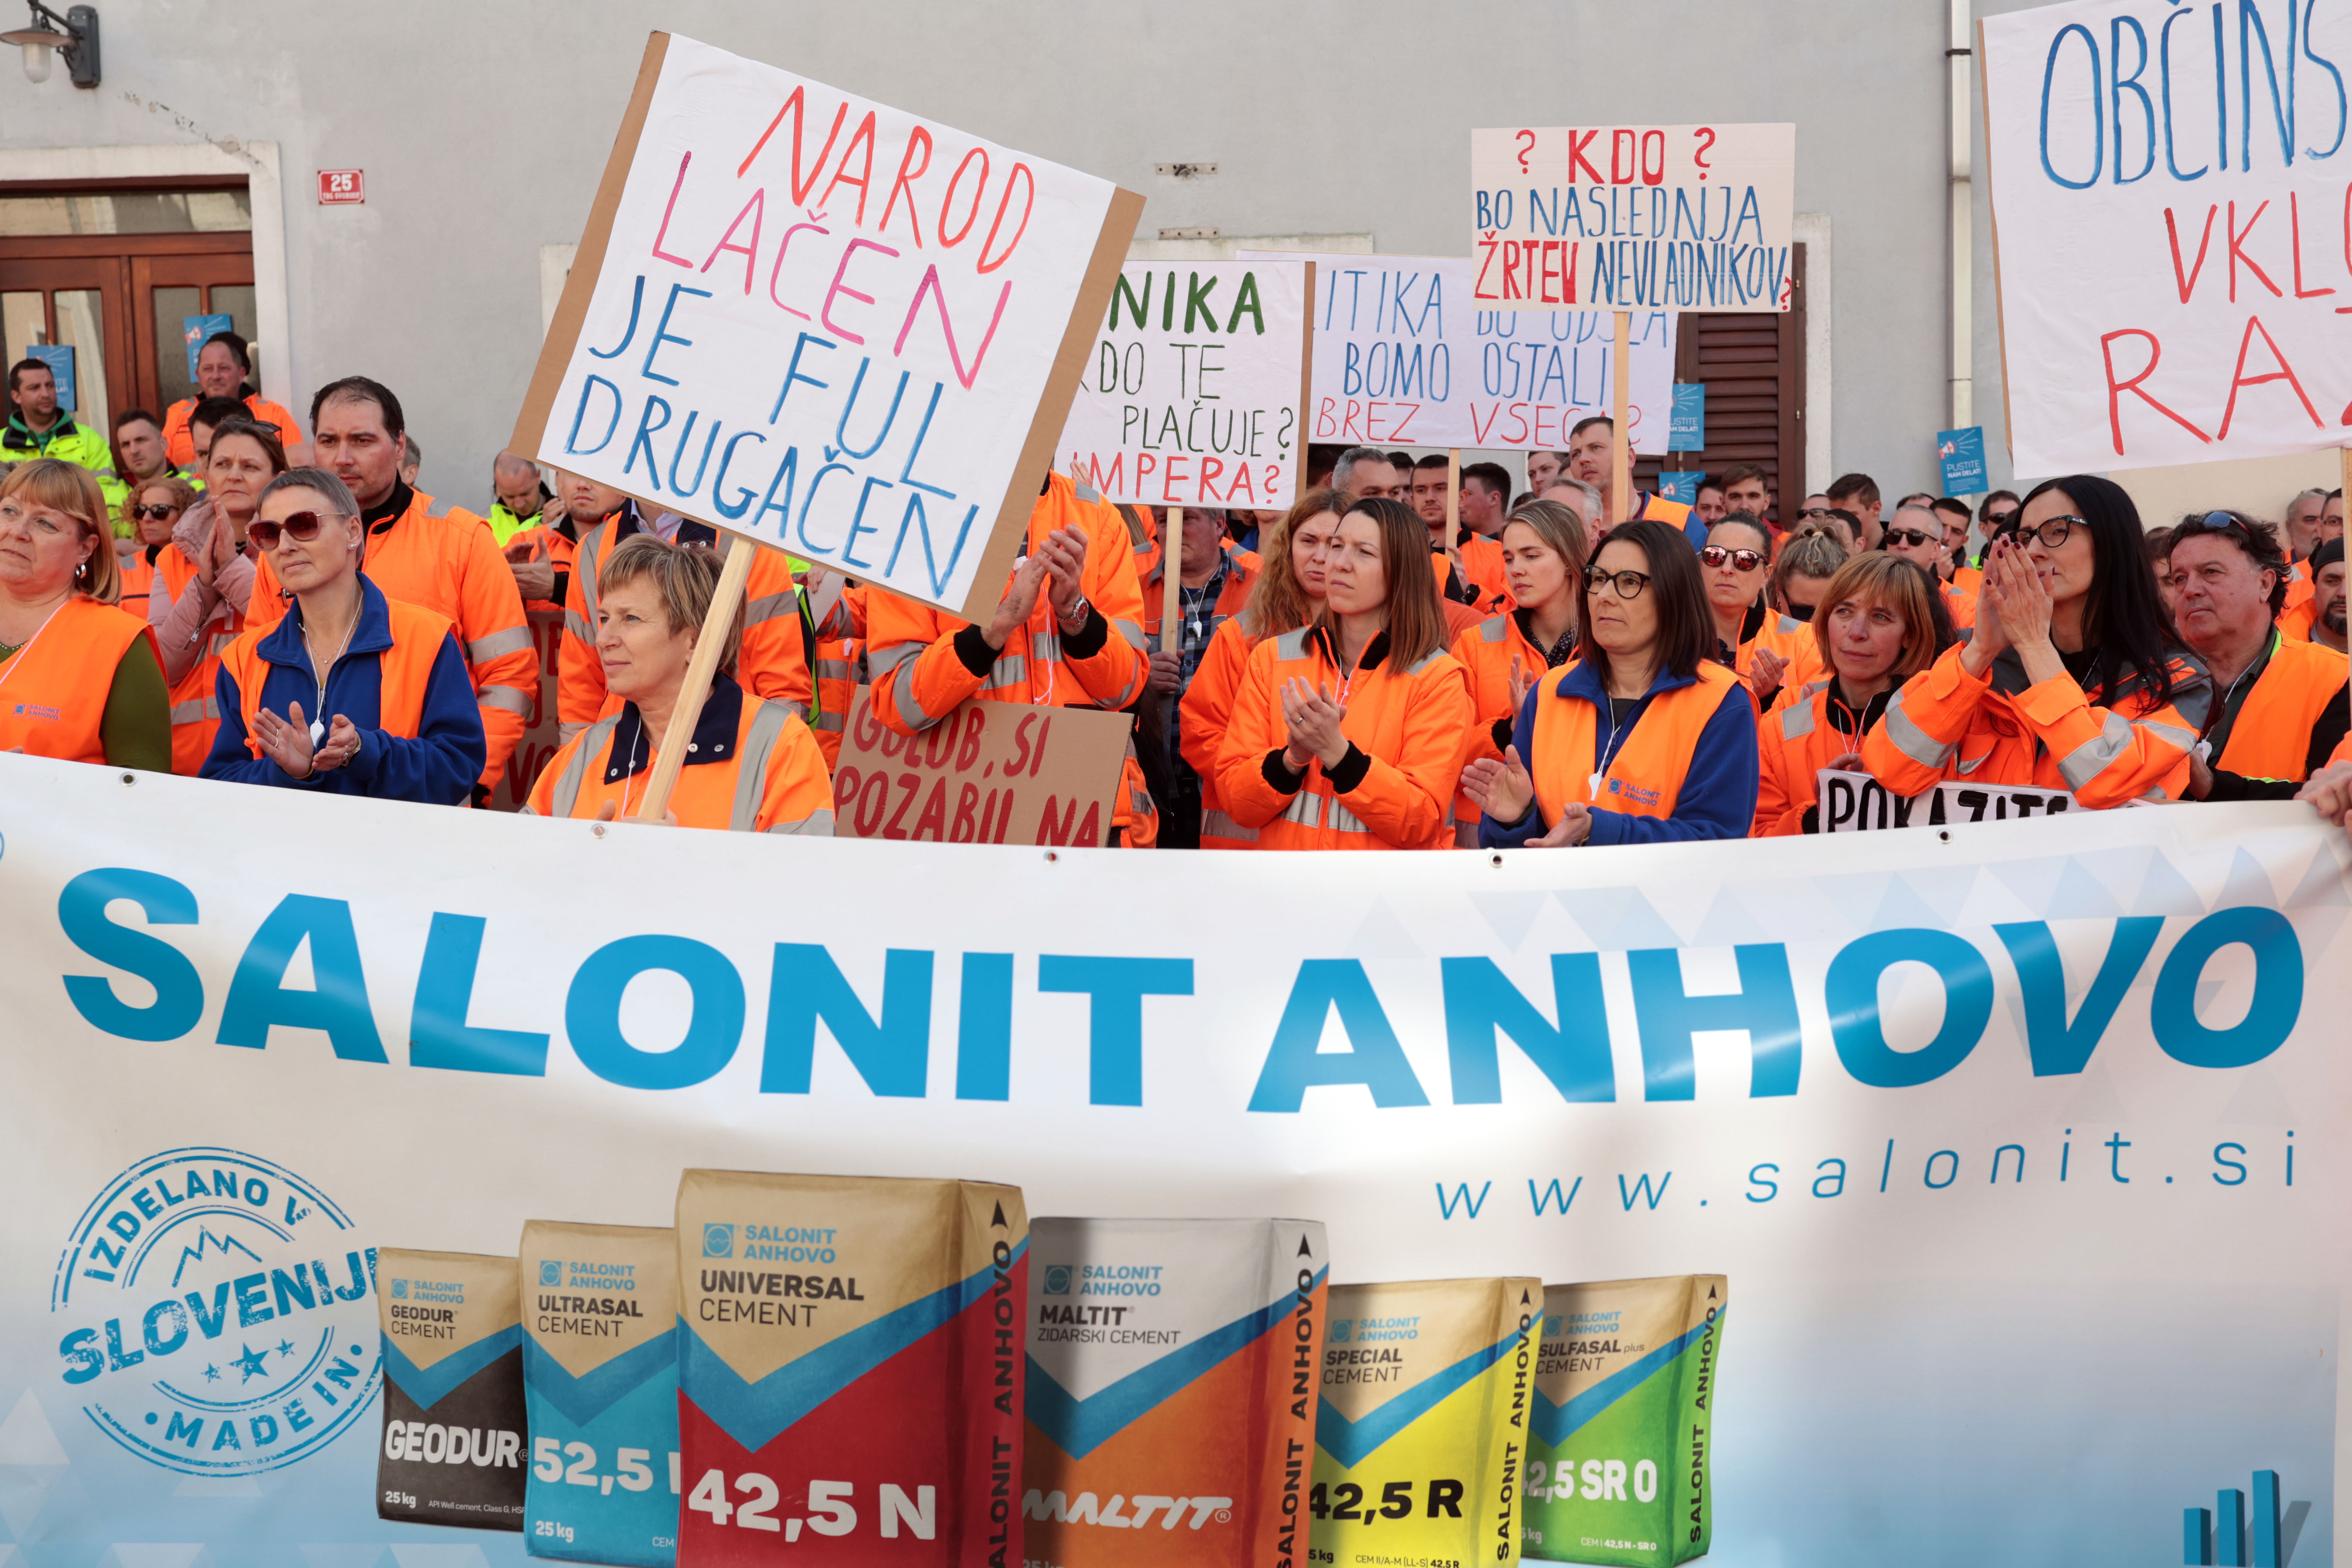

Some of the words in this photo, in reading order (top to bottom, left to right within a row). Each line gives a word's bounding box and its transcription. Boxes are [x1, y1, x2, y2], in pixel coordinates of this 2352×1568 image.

[1516, 129, 1535, 174] ?
[1568, 129, 1665, 185] KDO
[1694, 127, 1715, 180] ?
[331, 174, 352, 192] 25
[736, 85, 1035, 274] NAROD
[1476, 189, 1512, 230] BO
[1530, 186, 1762, 245] NASLEDNJA
[2164, 180, 2352, 304] VKL
[652, 151, 1012, 390] LAČEN
[1474, 231, 1579, 303] ŽRTEV
[1109, 270, 1265, 336] NIKA
[1314, 270, 1442, 339] ITIKA
[1081, 340, 1144, 395] DO
[1170, 343, 1225, 399] TE
[1344, 342, 1449, 402] BOMO
[1484, 342, 1606, 407] OSTALI
[588, 275, 713, 387] JE
[769, 331, 956, 500] FUL
[2101, 307, 2352, 456] RA
[1317, 397, 1420, 443] BREZ
[1947, 459, 1981, 472] PUSTITE
[564, 374, 979, 600] DRUGAČEN
[1074, 452, 1280, 505] MPERA?
[28, 710, 58, 720] ANHOVO
[30, 704, 60, 714] SALONIT
[1004, 712, 1051, 778] SI
[1624, 792, 1657, 806] ANHOVO
[1626, 784, 1661, 798] SALONIT
[1035, 794, 1099, 847] NA
[58, 867, 1194, 1107] SALONIT
[1246, 905, 2304, 1113] ANHOVO
[1436, 1128, 2294, 1220] www.salonit.si
[84, 1169, 269, 1282] IZDELANO
[285, 1196, 312, 1226] V
[744, 1225, 837, 1245] SALONIT
[744, 1243, 836, 1264] ANHOVO
[569, 1262, 635, 1277] SALONIT
[1082, 1265, 1164, 1280] SALONIT
[413, 1280, 464, 1292] SALONIT
[569, 1276, 635, 1291] ANHOVO
[701, 1269, 864, 1302] UNIVERSAL
[1080, 1282, 1161, 1296] ANHOVO
[413, 1292, 464, 1304] ANHOVO
[538, 1295, 643, 1317] ULTRASAL
[700, 1298, 818, 1328] CEMENT
[1359, 1317, 1420, 1329] SALONIT
[1569, 1311, 1622, 1323] SALONIT
[392, 1321, 456, 1340] CEMENT
[538, 1315, 623, 1337] CEMENT
[993, 1240, 1013, 1415] ANHOVO
[1037, 1328, 1105, 1343] ZIDARSKI
[1110, 1330, 1181, 1344] CEMENT
[1357, 1329, 1418, 1342] ANHOVO
[1566, 1323, 1619, 1335] ANHOVO
[1326, 1348, 1403, 1366] SPECIAL
[1539, 1340, 1621, 1357] SULFASAL
[1623, 1343, 1645, 1354] plus
[1695, 1307, 1716, 1411] ANHOVO
[1323, 1366, 1403, 1385] CEMENT
[1536, 1357, 1604, 1374] CEMENT
[165, 1397, 314, 1451] MADE
[312, 1356, 360, 1406] IN
[1276, 1439, 1304, 1568] SALONIT
[1291, 1269, 1313, 1421] ANHOVO
[1497, 1442, 1518, 1561] SALONIT
[1510, 1314, 1531, 1428] ANHOVO
[533, 1436, 654, 1495] 52,5
[1580, 1459, 1627, 1501] SR
[1690, 1424, 1704, 1543] SALONIT
[385, 1491, 401, 1504] 25
[402, 1492, 416, 1509] kg
[484, 1504, 502, 1513] Class
[688, 1468, 858, 1543] 42,5
[879, 1483, 936, 1540] N
[1310, 1482, 1412, 1525] 42,5
[1427, 1479, 1463, 1518] R
[536, 1520, 554, 1537] 25
[556, 1522, 574, 1543] kg
[652, 1537, 674, 1547] CEM
[1528, 1528, 1542, 1544] kg
[1581, 1537, 1598, 1546] CEM
[1604, 1539, 1623, 1549] 42,5
[1624, 1541, 1631, 1549] N
[1637, 1541, 1649, 1550] SR
[1319, 1550, 1334, 1563] kg
[1356, 1555, 1374, 1563] CEM
